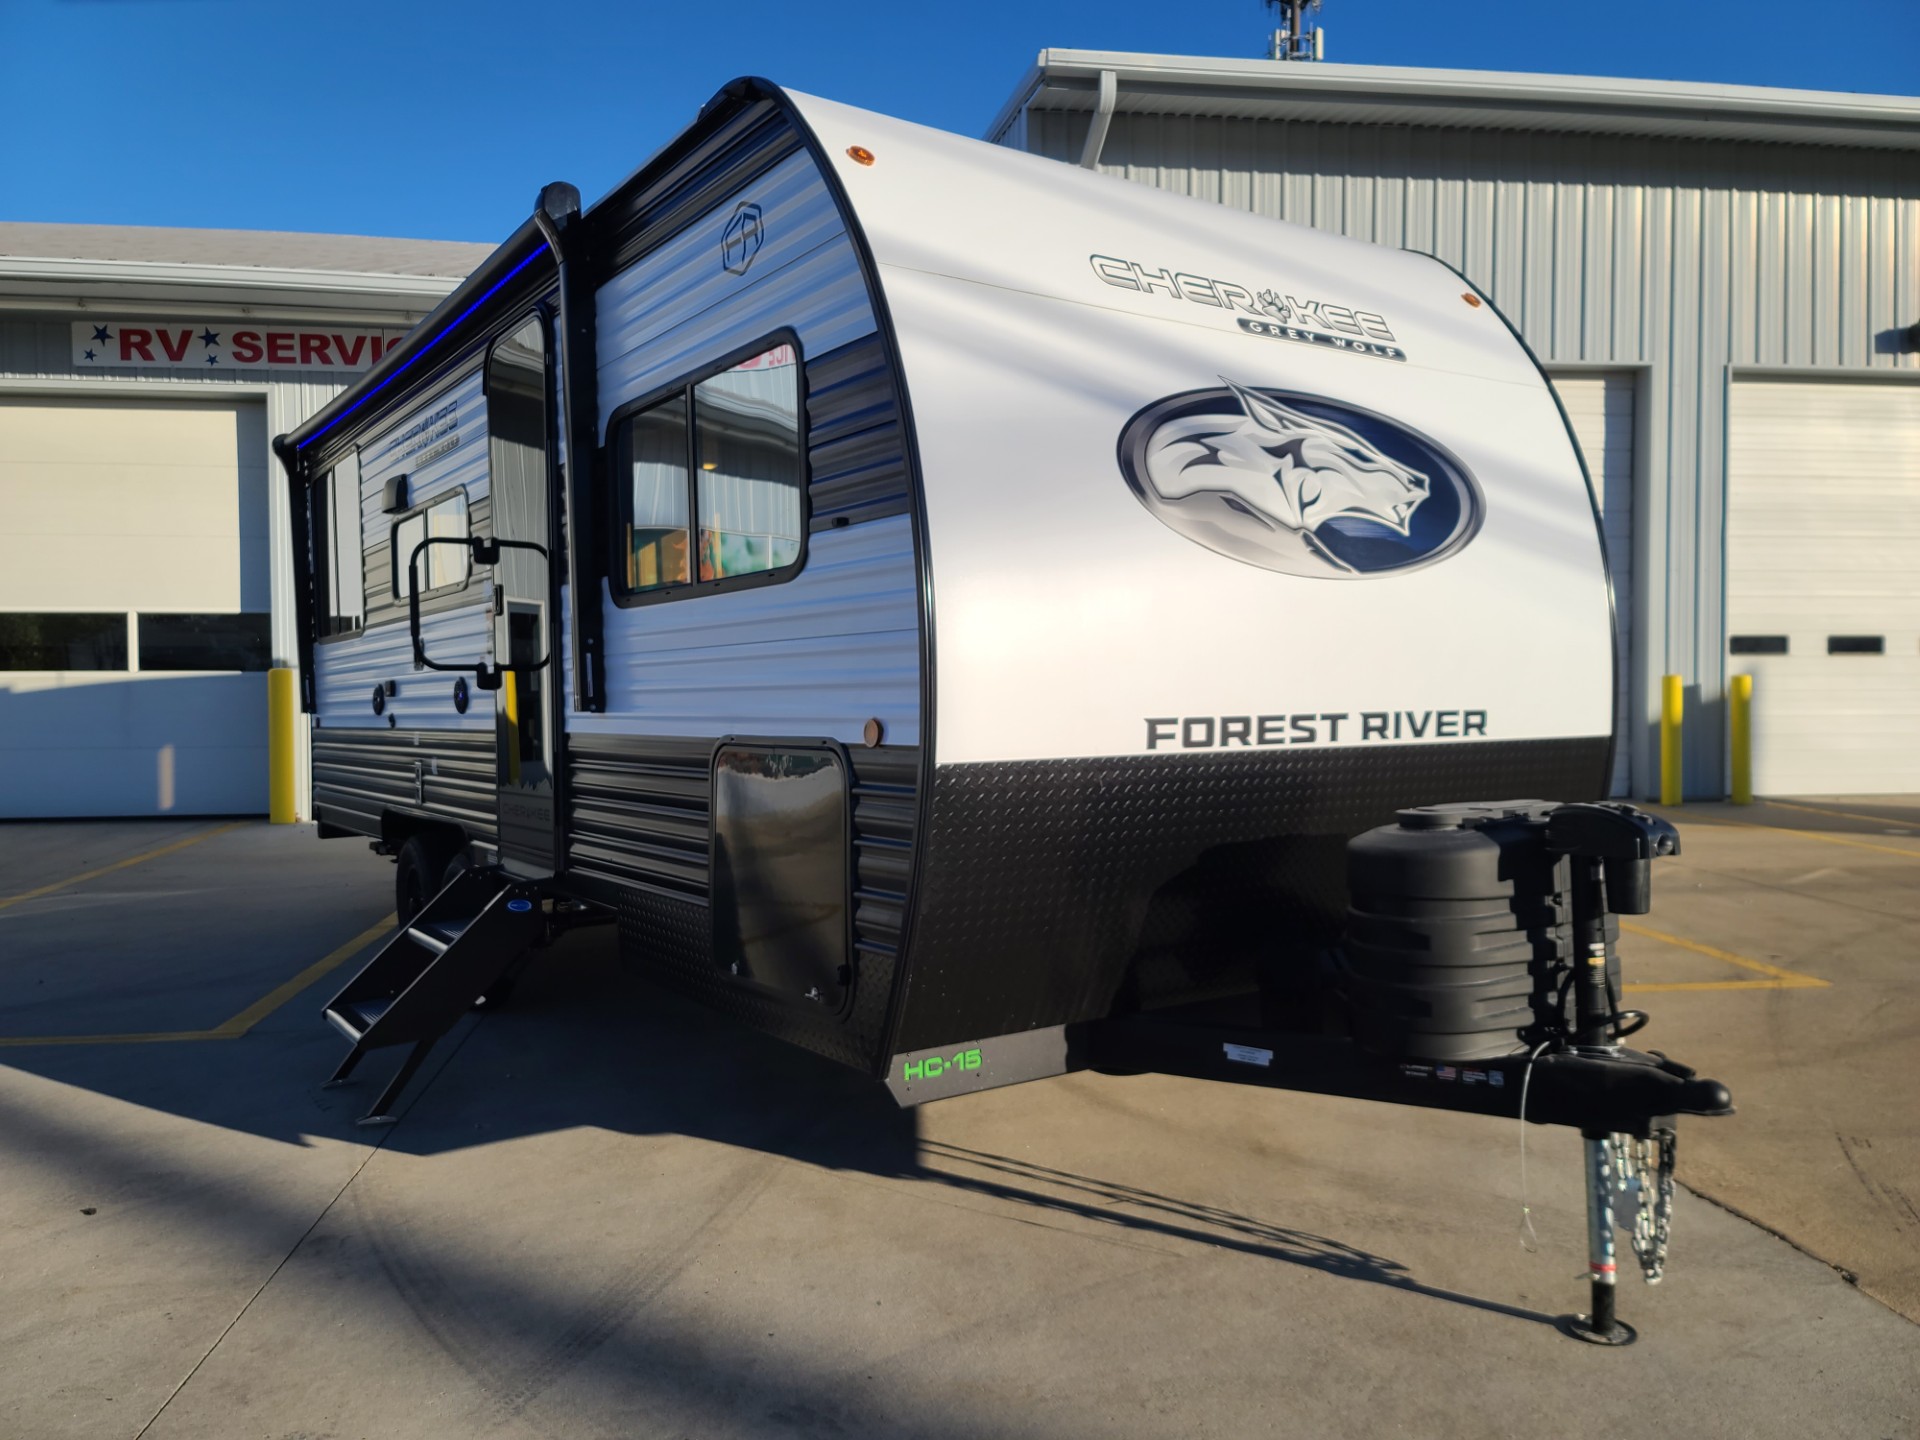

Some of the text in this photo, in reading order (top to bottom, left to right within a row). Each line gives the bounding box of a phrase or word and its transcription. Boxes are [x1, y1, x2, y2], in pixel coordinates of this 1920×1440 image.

[118, 328, 404, 366] RV SERVI
[1249, 322, 1398, 358] GREY WOLF
[1143, 709, 1488, 750] FOREST RIVER
[904, 1048, 982, 1082] HC-15
